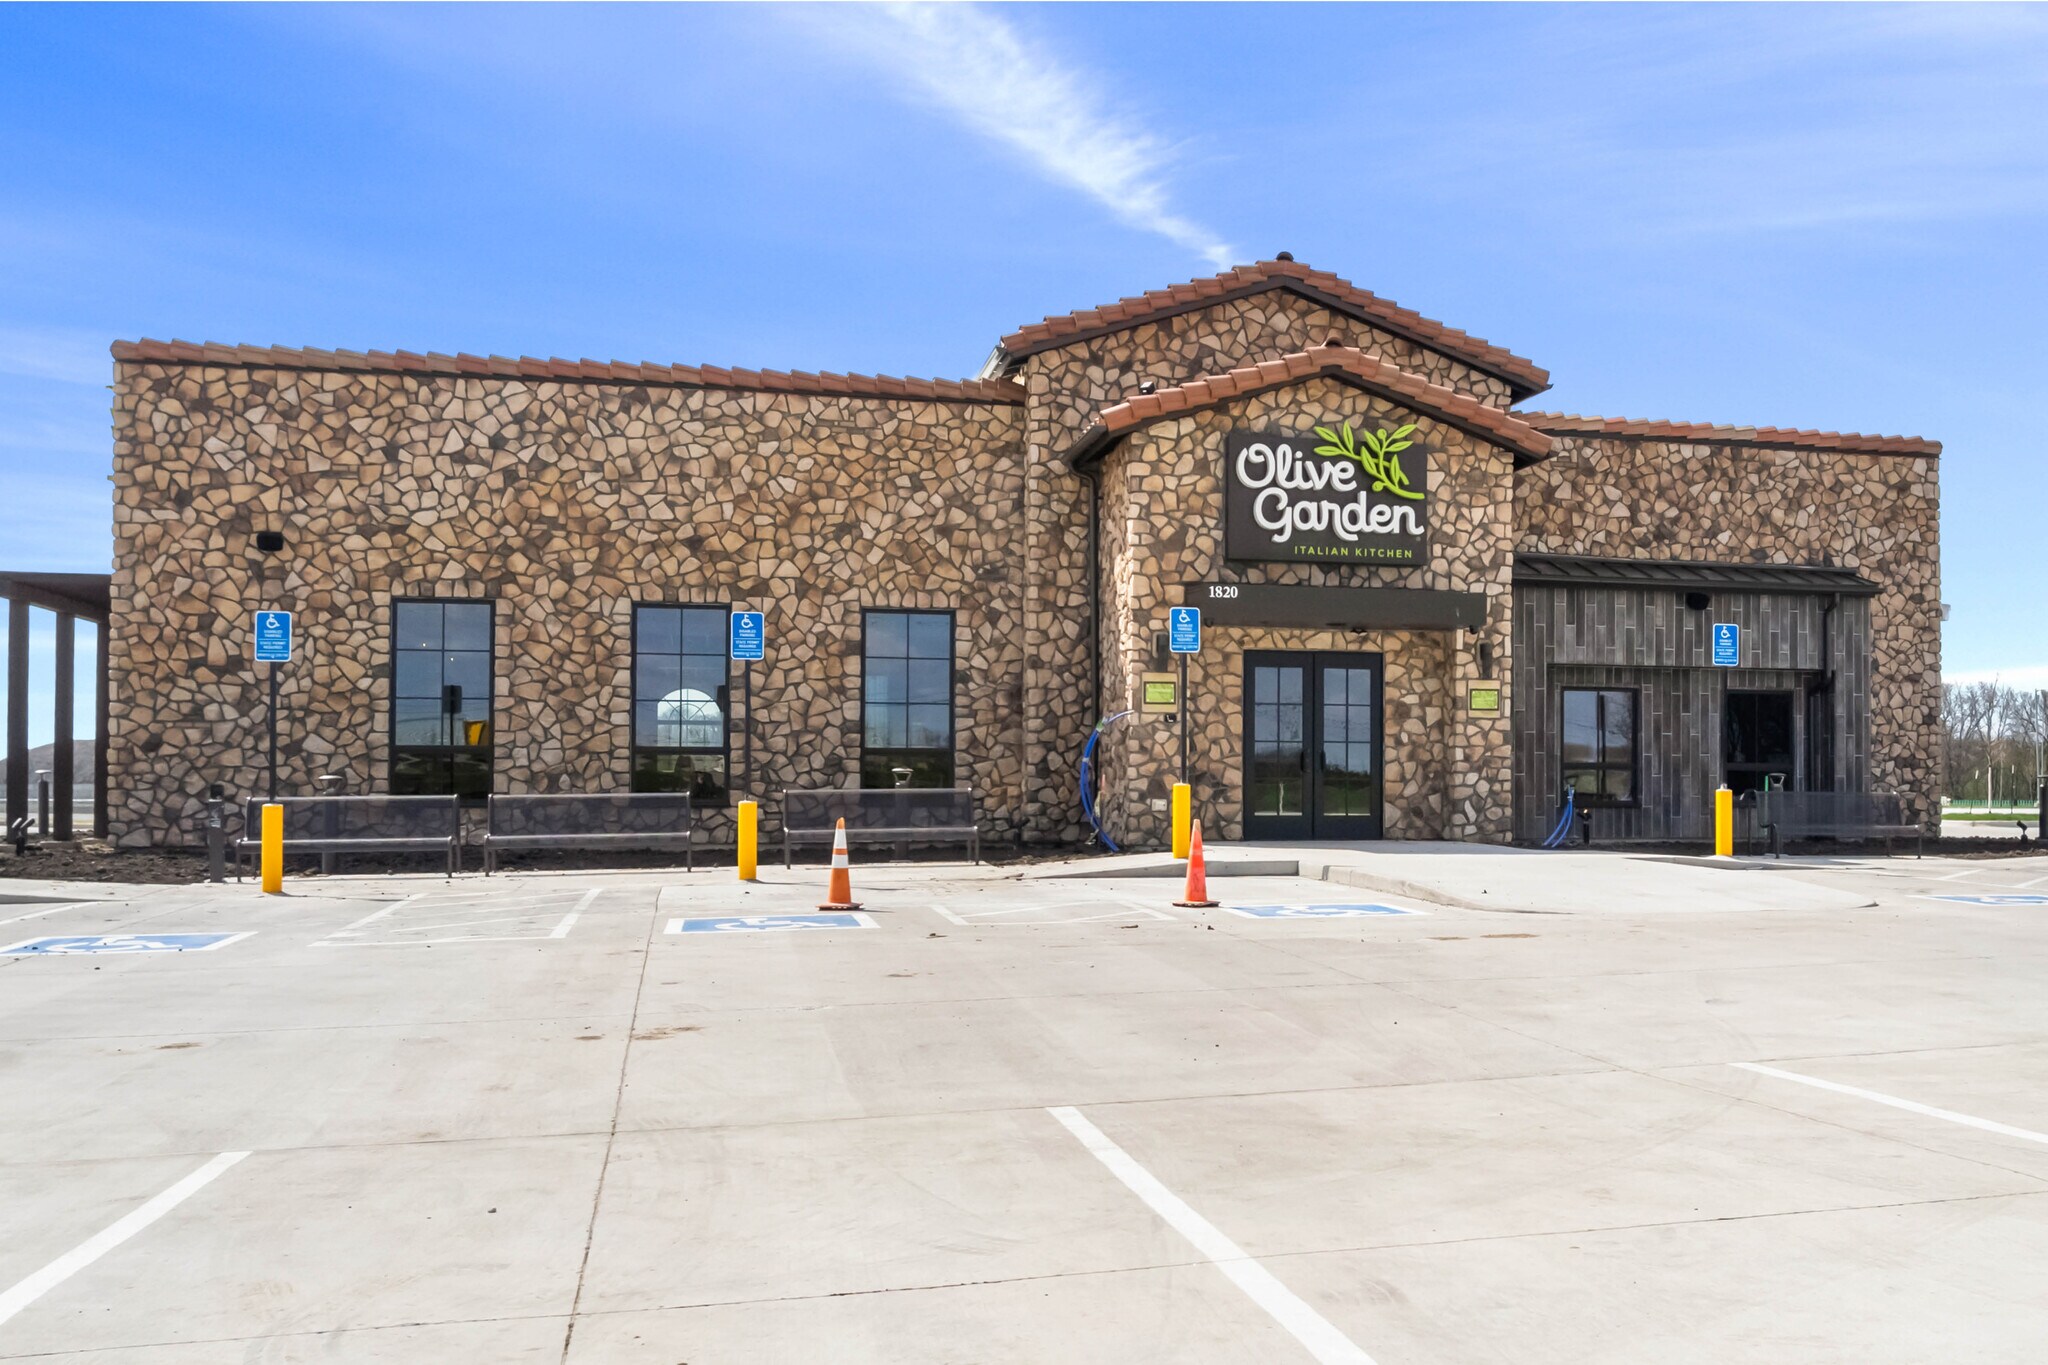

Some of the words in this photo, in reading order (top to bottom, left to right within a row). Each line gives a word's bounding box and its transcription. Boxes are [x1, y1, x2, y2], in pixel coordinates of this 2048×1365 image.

[1236, 443, 1357, 492] Olive
[1253, 487, 1425, 543] Garden
[1294, 545, 1349, 557] ITALIAN
[1355, 547, 1412, 559] KITCHEN
[1208, 585, 1239, 599] 1820
